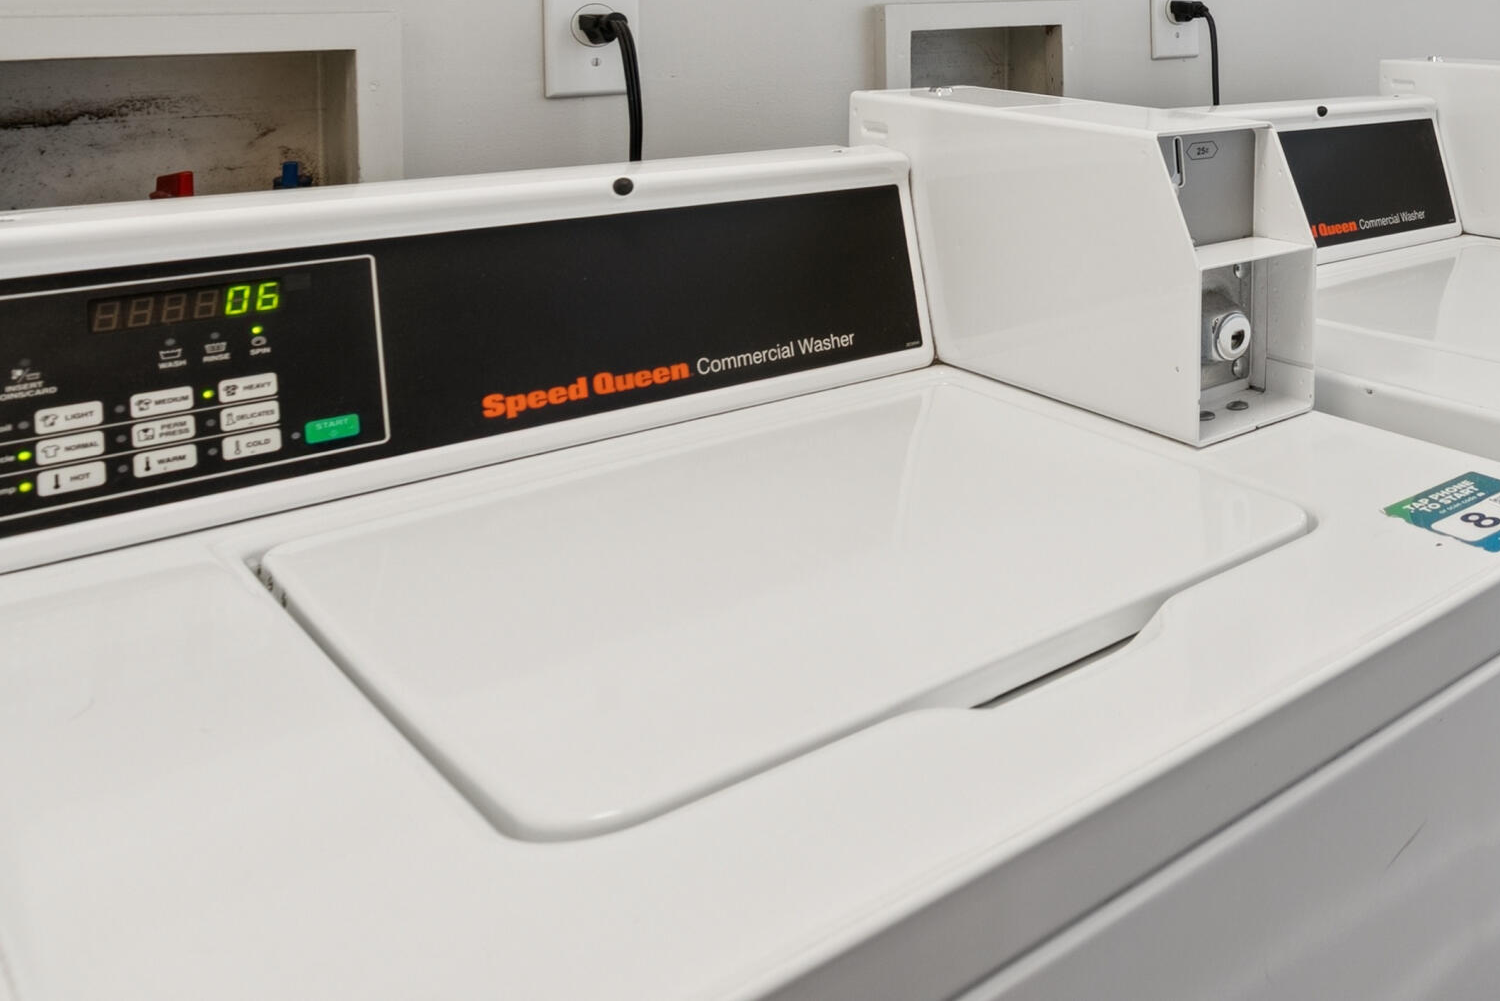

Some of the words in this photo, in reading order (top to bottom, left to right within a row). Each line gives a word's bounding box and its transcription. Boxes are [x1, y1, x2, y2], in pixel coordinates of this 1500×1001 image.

[1318, 220, 1358, 238] Queen
[1359, 214, 1400, 230] Commercial
[1400, 210, 1425, 223] Washer
[225, 282, 280, 315] 06
[249, 347, 271, 356] SPIN
[202, 352, 231, 363] RINSE
[158, 359, 187, 369] WASH
[482, 377, 589, 419] Speed
[593, 362, 690, 395] Queen
[696, 342, 795, 375] Commercial
[797, 331, 855, 355] Washer
[4, 380, 44, 393] INSERT
[242, 381, 272, 391] HEAVY
[0, 386, 58, 401] OINS/CARD
[154, 394, 189, 406] MEDIUM
[64, 410, 94, 421] LIGHT
[236, 409, 275, 421] DELICATES
[160, 421, 187, 430] PERM
[315, 417, 349, 430] START
[159, 428, 190, 438] PRESS
[64, 441, 98, 451] NORMAL
[246, 438, 271, 448] COLD
[156, 454, 186, 465] WARM
[70, 472, 91, 481] HOT
[1402, 496, 1430, 512] TAP
[1431, 479, 1475, 500] PHONE
[1420, 501, 1441, 513] TO
[1439, 485, 1479, 505] START
